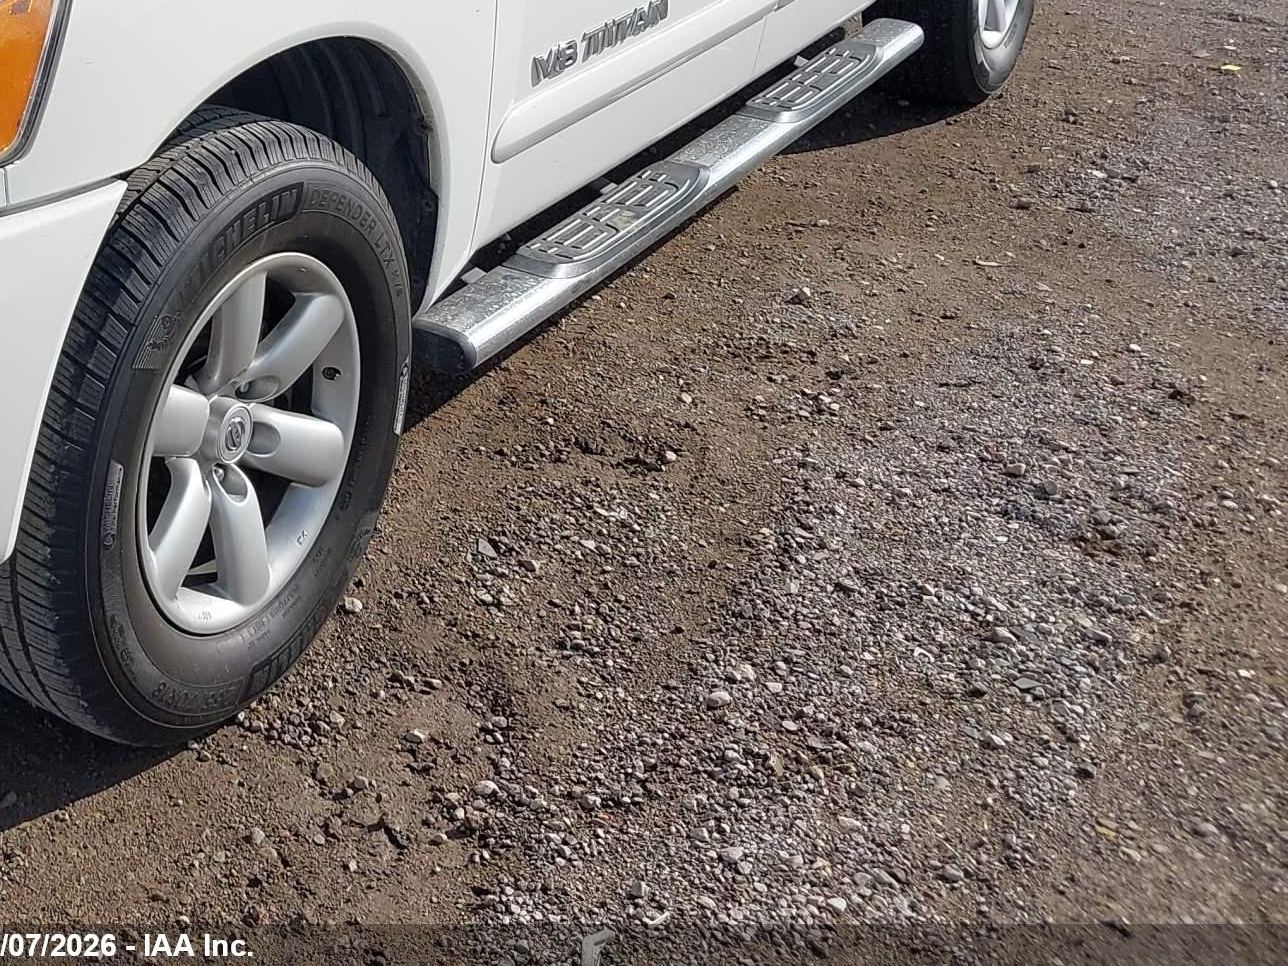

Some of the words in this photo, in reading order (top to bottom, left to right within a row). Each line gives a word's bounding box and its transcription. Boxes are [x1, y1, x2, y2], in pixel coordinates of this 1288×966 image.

[530, 39, 579, 88] V8
[309, 187, 377, 235] DEFENDER
[374, 233, 395, 270] LTX
